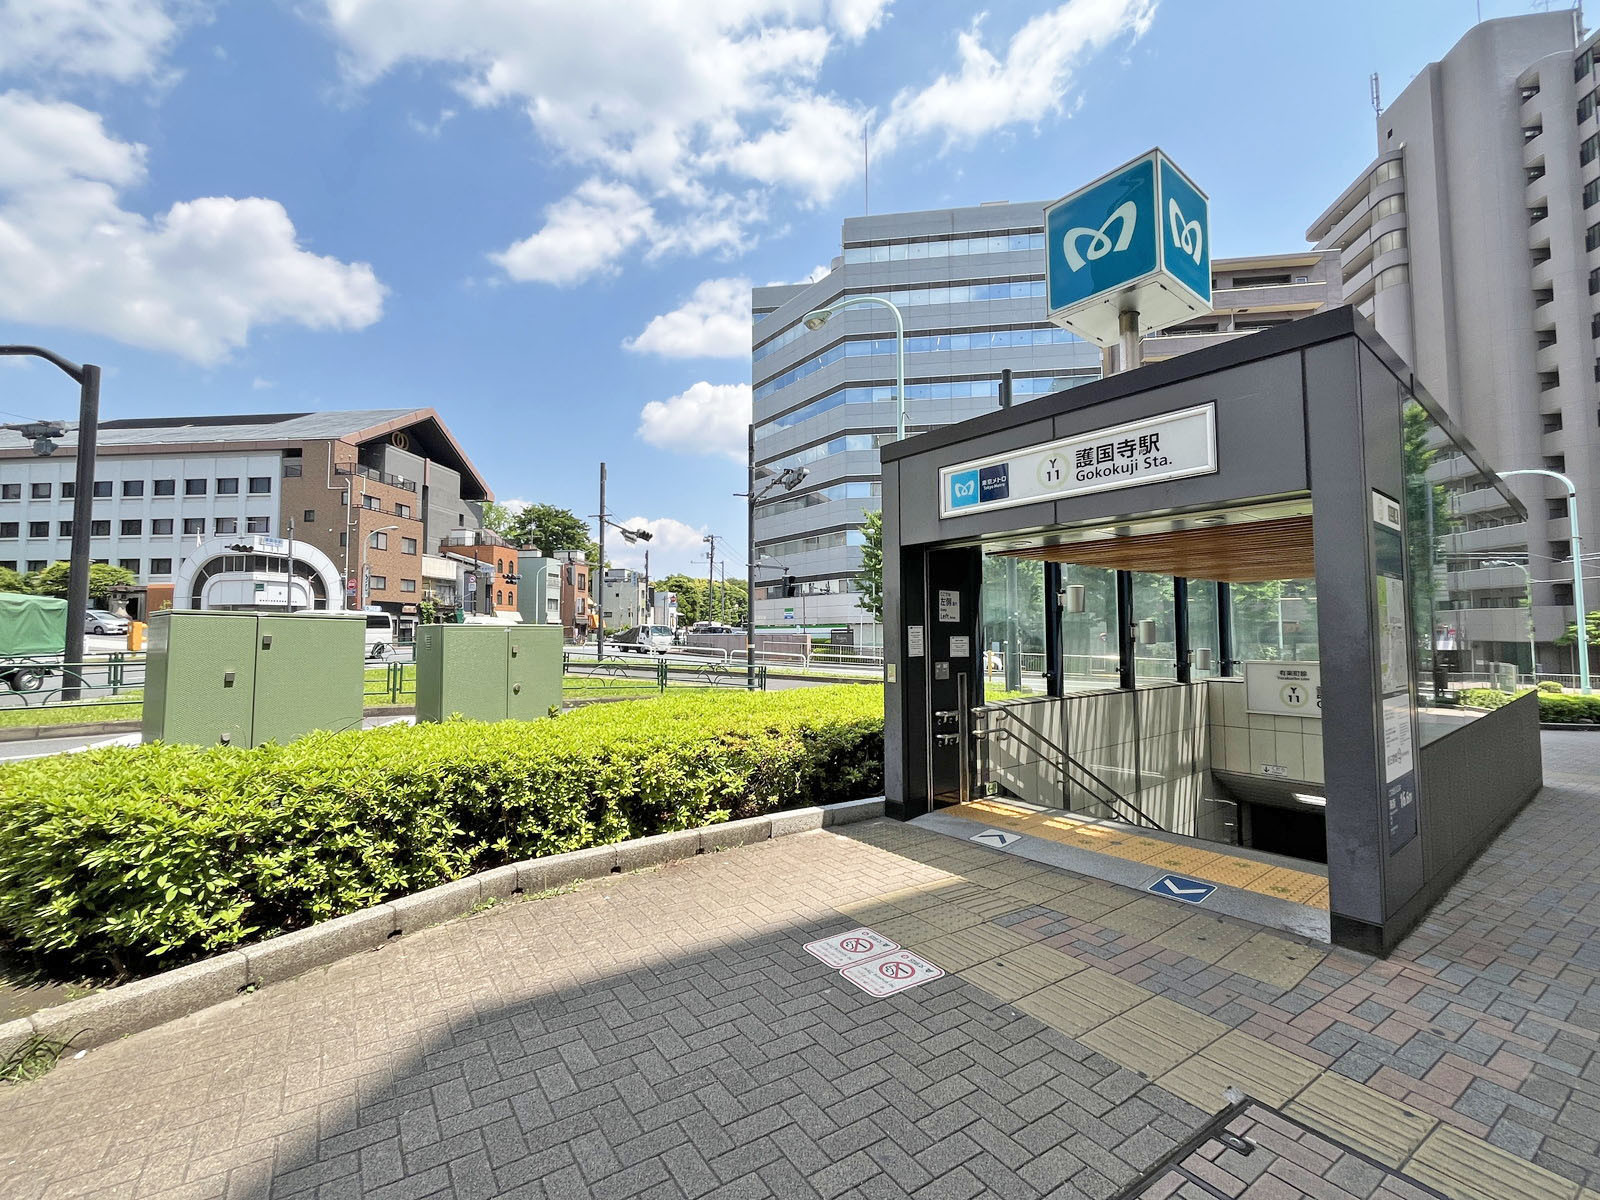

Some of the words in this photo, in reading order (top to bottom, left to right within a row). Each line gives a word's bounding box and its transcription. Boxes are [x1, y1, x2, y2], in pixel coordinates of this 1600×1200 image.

[1075, 433, 1160, 469] 護国寺駅
[1049, 459, 1057, 469] Y
[1076, 459, 1138, 481] Gokokuji
[1144, 456, 1173, 470] Sta.
[1046, 470, 1060, 481] 11
[1288, 694, 1300, 703] 11
